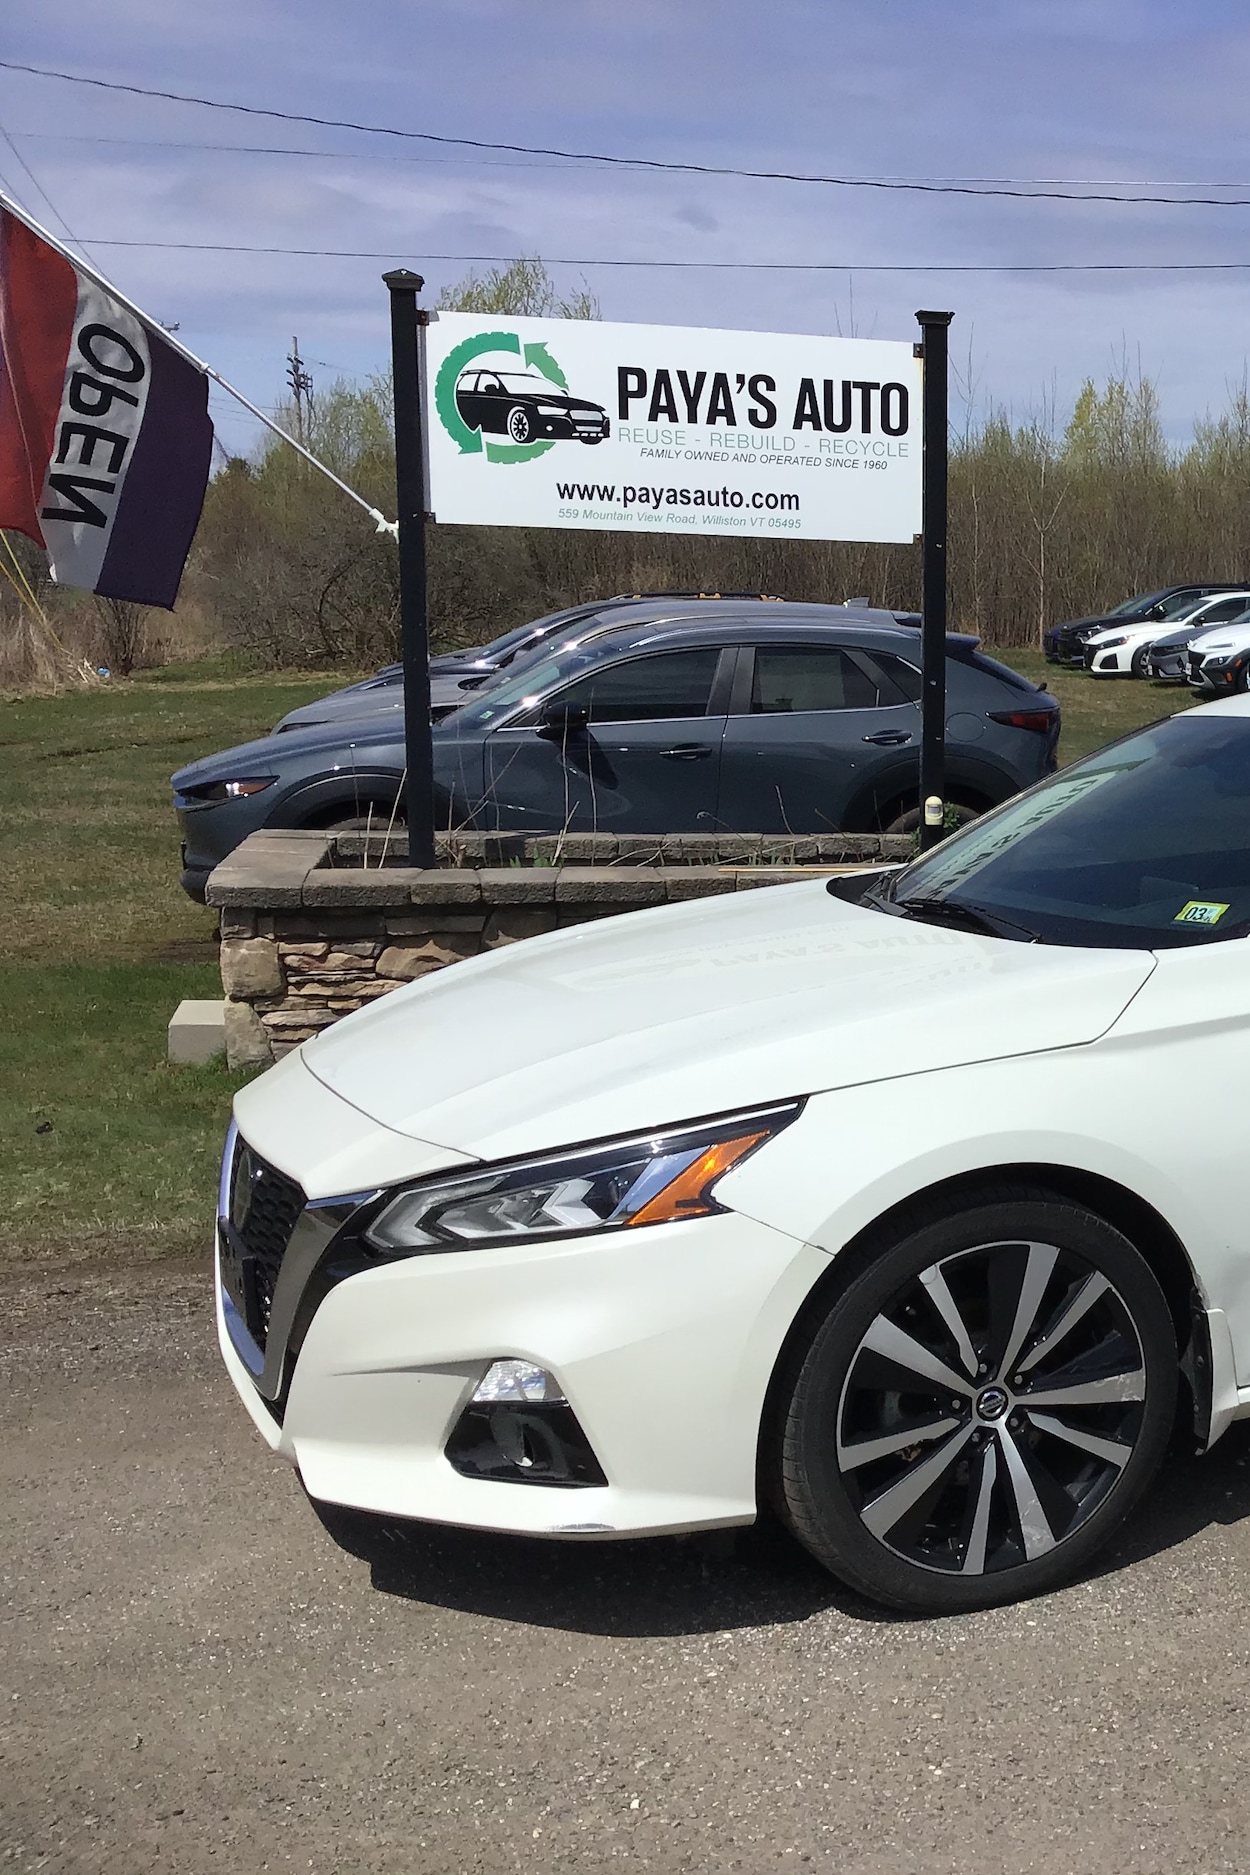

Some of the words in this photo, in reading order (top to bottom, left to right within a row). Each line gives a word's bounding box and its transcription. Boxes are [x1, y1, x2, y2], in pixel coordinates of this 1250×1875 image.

[617, 366, 777, 429] PAYA'S
[792, 377, 909, 436] AUTO
[618, 427, 686, 446] REUSE
[710, 432, 796, 452] REBUILD
[819, 438, 909, 458] RECYCLE
[640, 447, 682, 459] FAMILY
[684, 450, 729, 462] OWNED
[731, 453, 757, 464] AND
[759, 454, 822, 467] OPERATED
[825, 457, 860, 469] SINCE
[863, 460, 888, 470] 1960
[556, 482, 800, 511] www.payasauto.com
[558, 508, 579, 519] 559
[582, 509, 633, 521] Mountain
[637, 511, 663, 523] View
[666, 512, 698, 525] Road,
[702, 515, 746, 527] Williston
[750, 517, 765, 527] VT
[768, 518, 801, 529] 05495
[1184, 906, 1208, 921] 03
